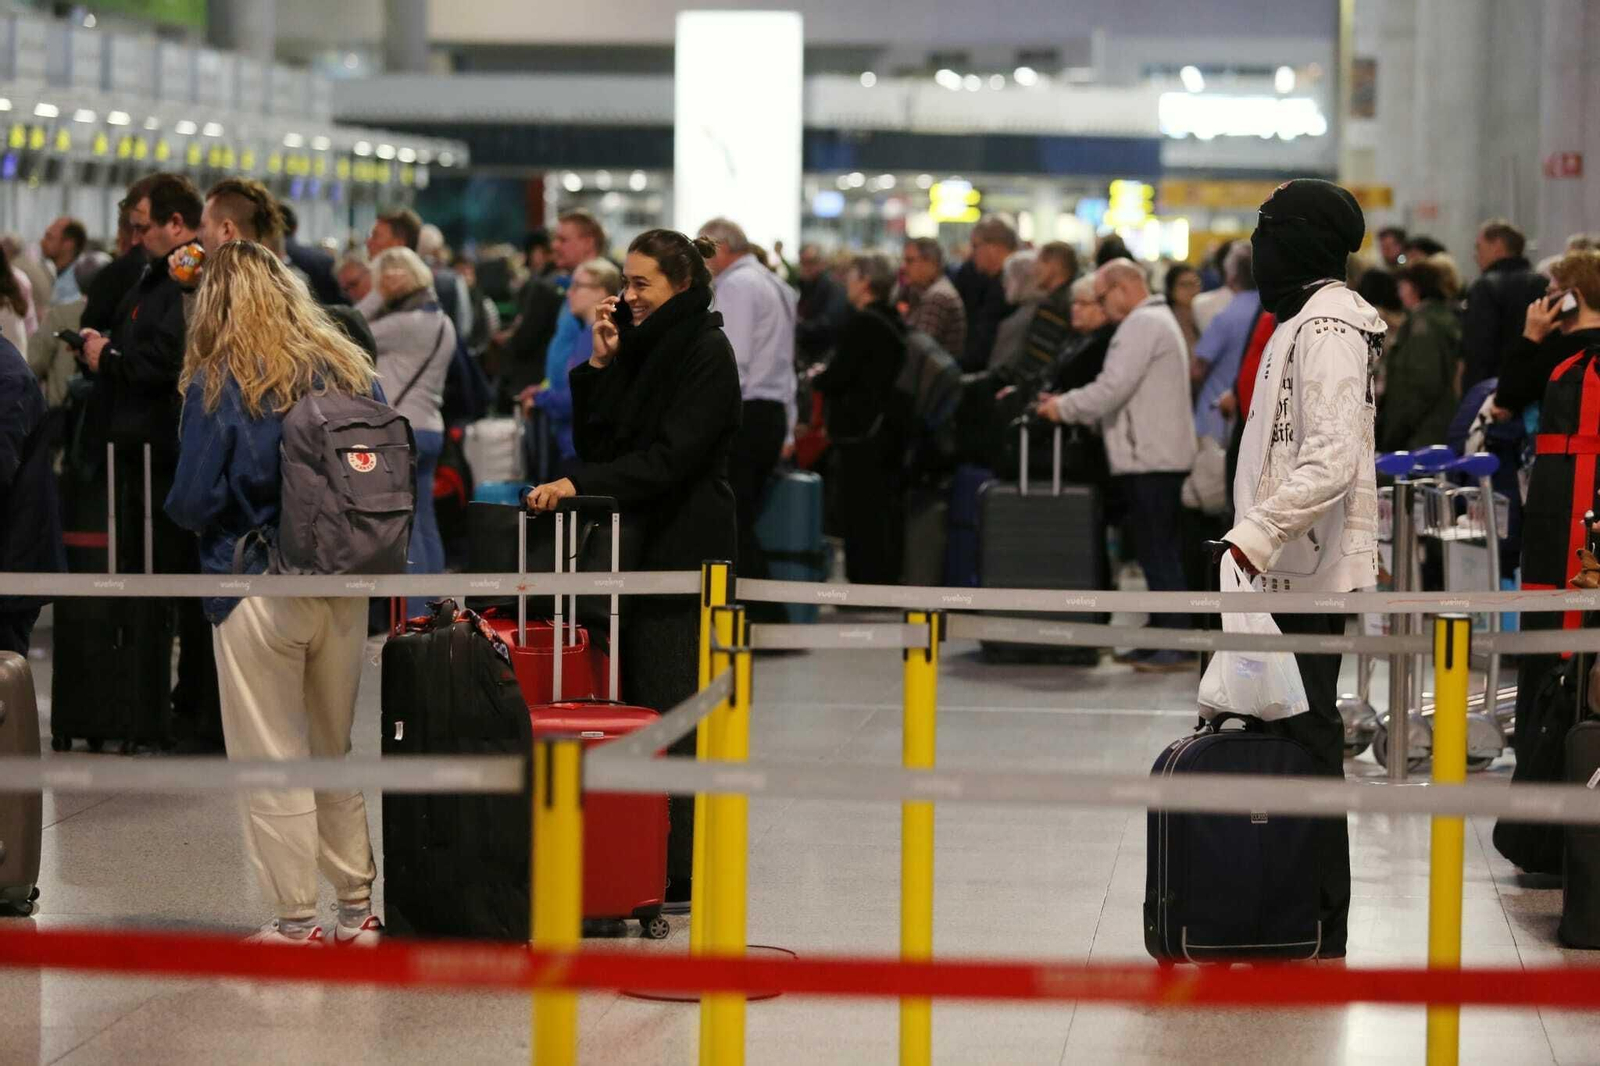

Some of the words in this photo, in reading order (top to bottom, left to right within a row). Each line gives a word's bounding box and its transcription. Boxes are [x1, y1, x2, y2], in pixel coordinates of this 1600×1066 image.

[94, 578, 125, 590] vueling
[219, 579, 250, 591] vueling
[346, 579, 376, 590] vueling
[469, 578, 500, 589] vueling
[816, 589, 848, 601] vueling
[941, 593, 973, 604] vueling
[1564, 594, 1596, 605] vueling
[1065, 596, 1096, 607] vueling
[1189, 597, 1221, 608] vueling
[1314, 598, 1345, 608] vueling
[1439, 598, 1470, 608] vueling
